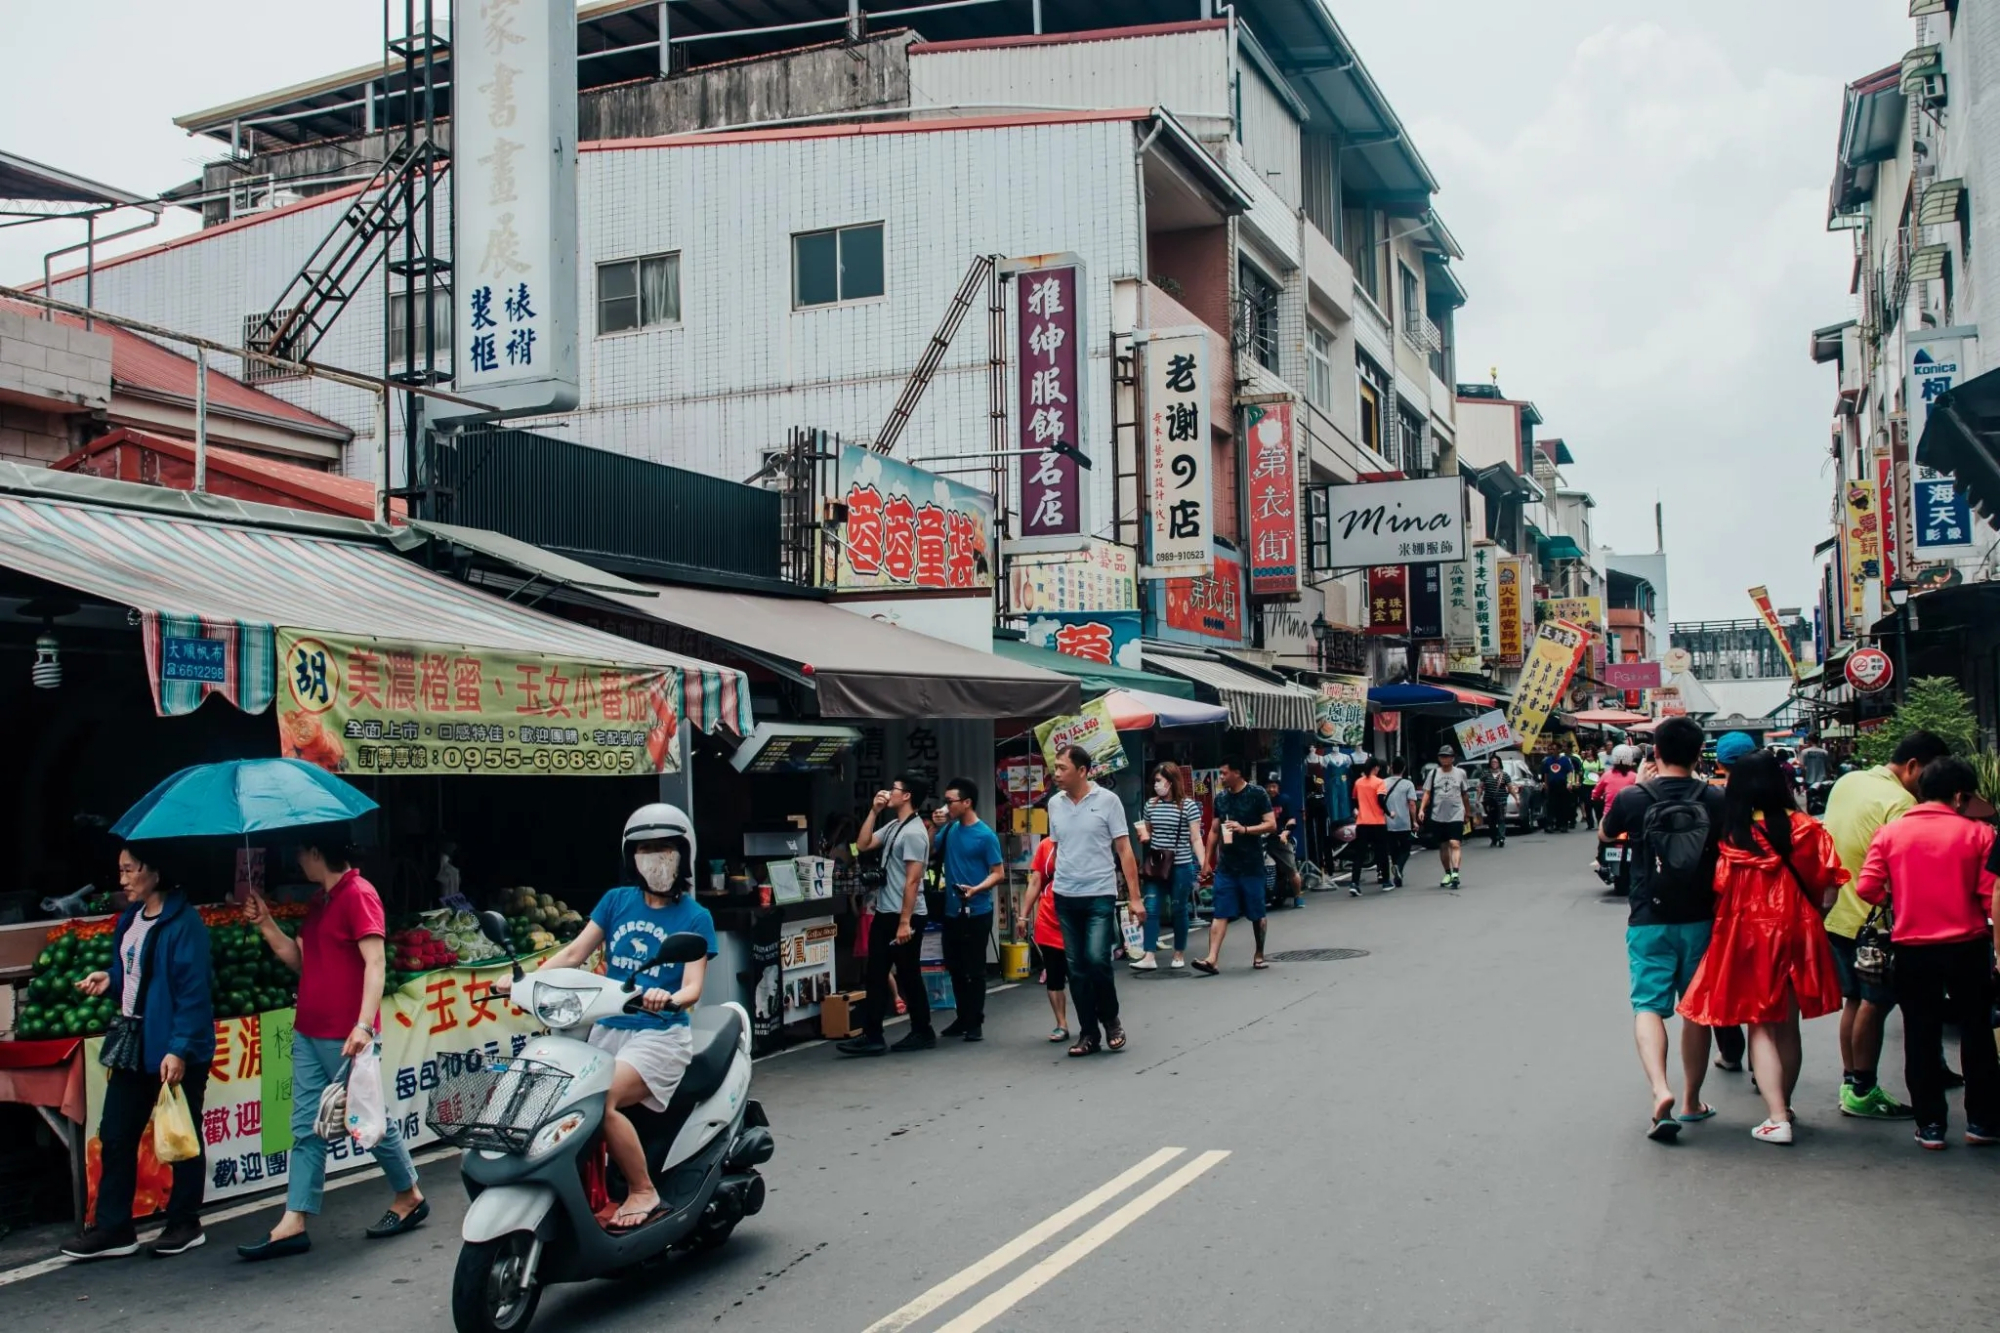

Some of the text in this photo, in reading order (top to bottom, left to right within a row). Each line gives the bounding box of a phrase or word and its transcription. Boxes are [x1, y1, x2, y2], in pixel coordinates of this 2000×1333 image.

[1914, 363, 1957, 375] Konica
[1338, 502, 1452, 539] Mina
[1398, 540, 1453, 556] 米娜服飾
[169, 641, 223, 662] 大順帆布
[295, 648, 329, 703] 胡
